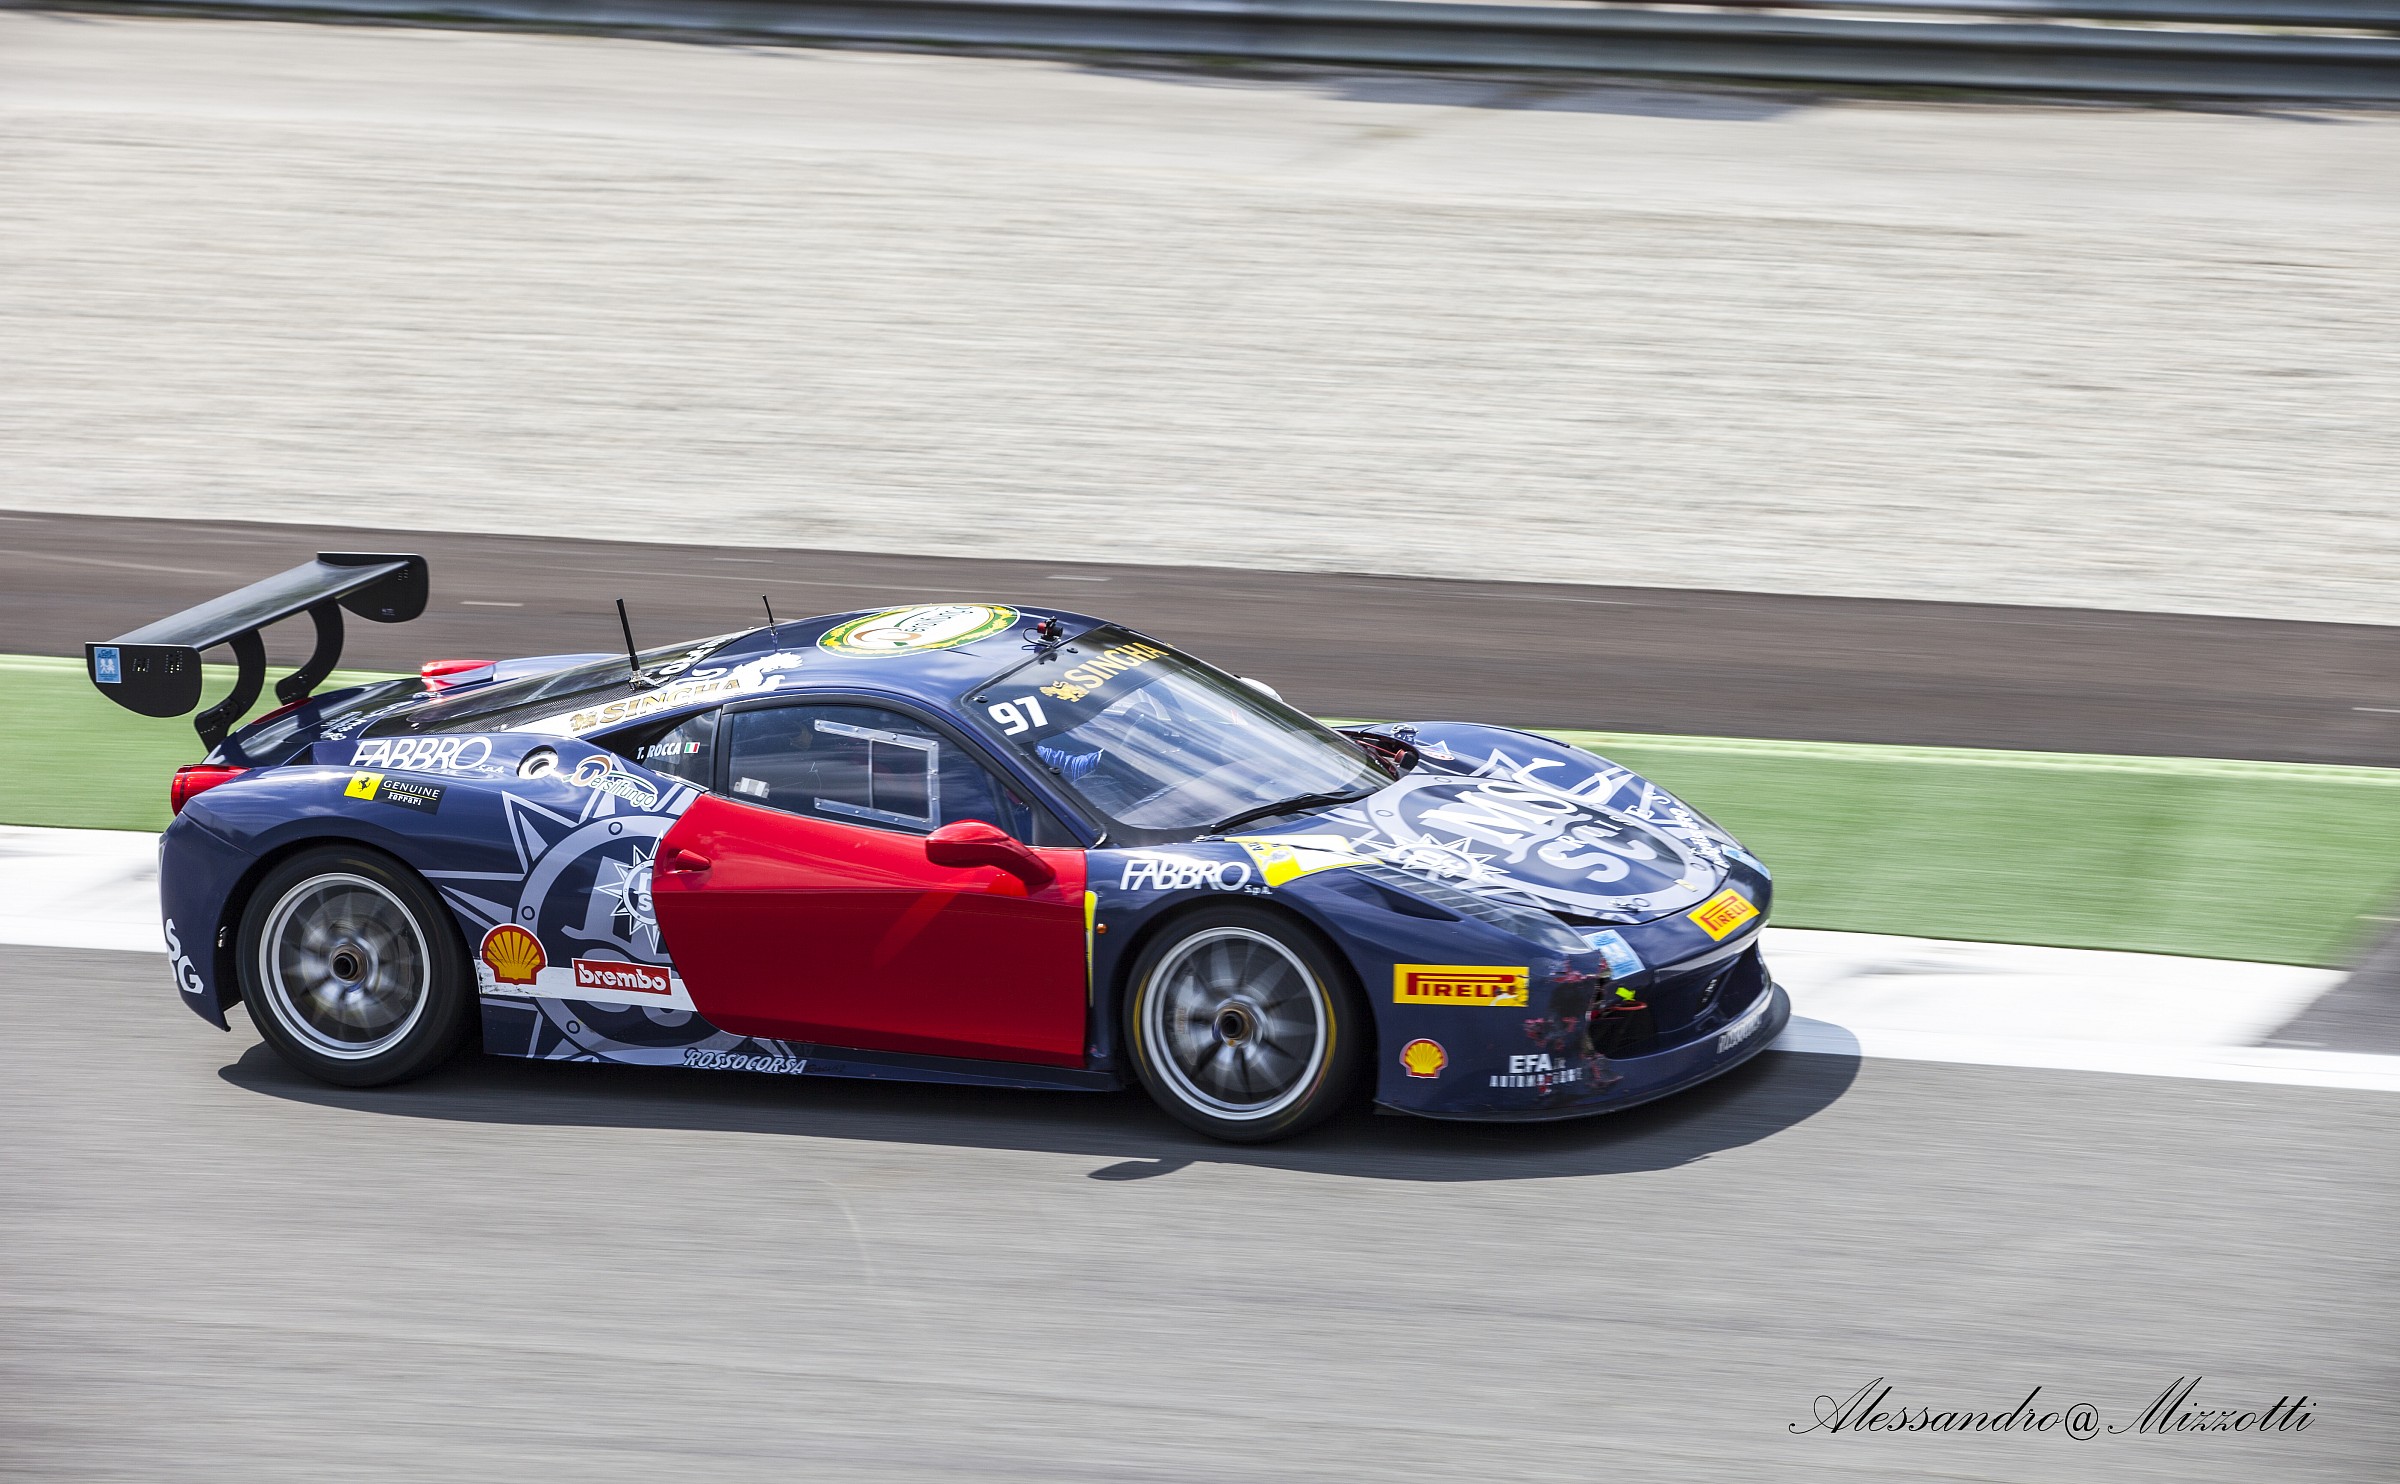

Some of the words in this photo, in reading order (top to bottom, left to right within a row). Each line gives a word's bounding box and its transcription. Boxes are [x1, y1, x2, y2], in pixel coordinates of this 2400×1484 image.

[1063, 641, 1169, 690] SINGHA
[599, 678, 742, 724] SINGHA
[987, 695, 1048, 736] 97
[349, 736, 493, 770] FABBRO
[636, 746, 645, 760] T.
[646, 742, 682, 758] ROCCA
[383, 780, 441, 798] GENUINE
[387, 791, 423, 806] Ferrari
[1119, 859, 1251, 891] FABBRO
[1700, 895, 1749, 933] PIRELLI
[578, 963, 667, 992] brembo
[684, 1047, 808, 1075] ROSSOCORSA
[1508, 1053, 1553, 1074] EFA
